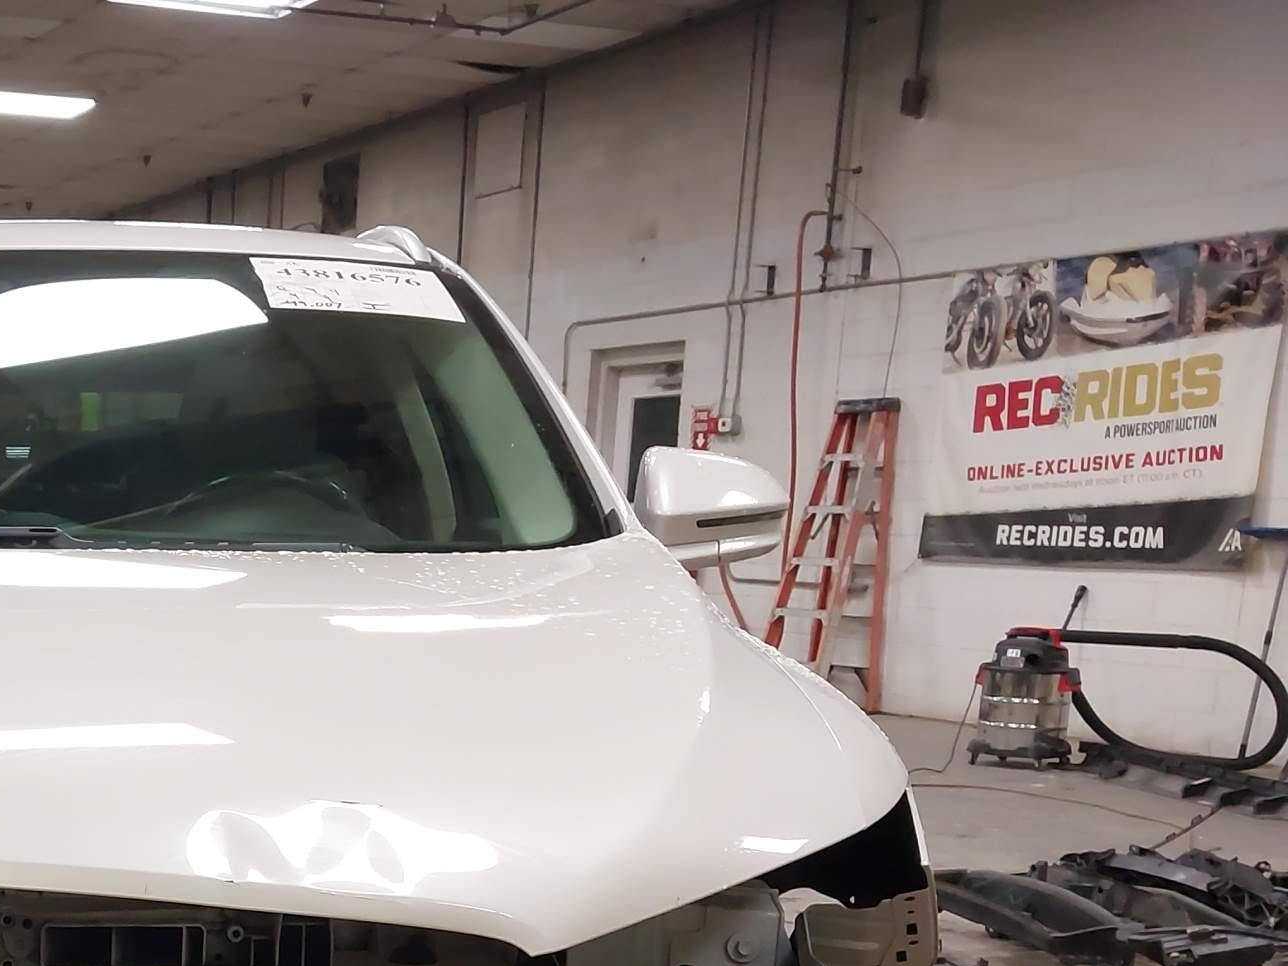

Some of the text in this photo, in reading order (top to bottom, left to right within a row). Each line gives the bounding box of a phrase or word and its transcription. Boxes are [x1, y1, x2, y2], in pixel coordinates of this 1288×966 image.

[277, 267, 422, 287] 43816576
[973, 353, 1224, 433] REC RIDES
[1104, 414, 1218, 439] A POWERSPORT AUCTION
[967, 444, 1224, 481] ONLINE-EXCLUSIVE AUCTION
[996, 524, 1164, 549] RECRIDES.COM
